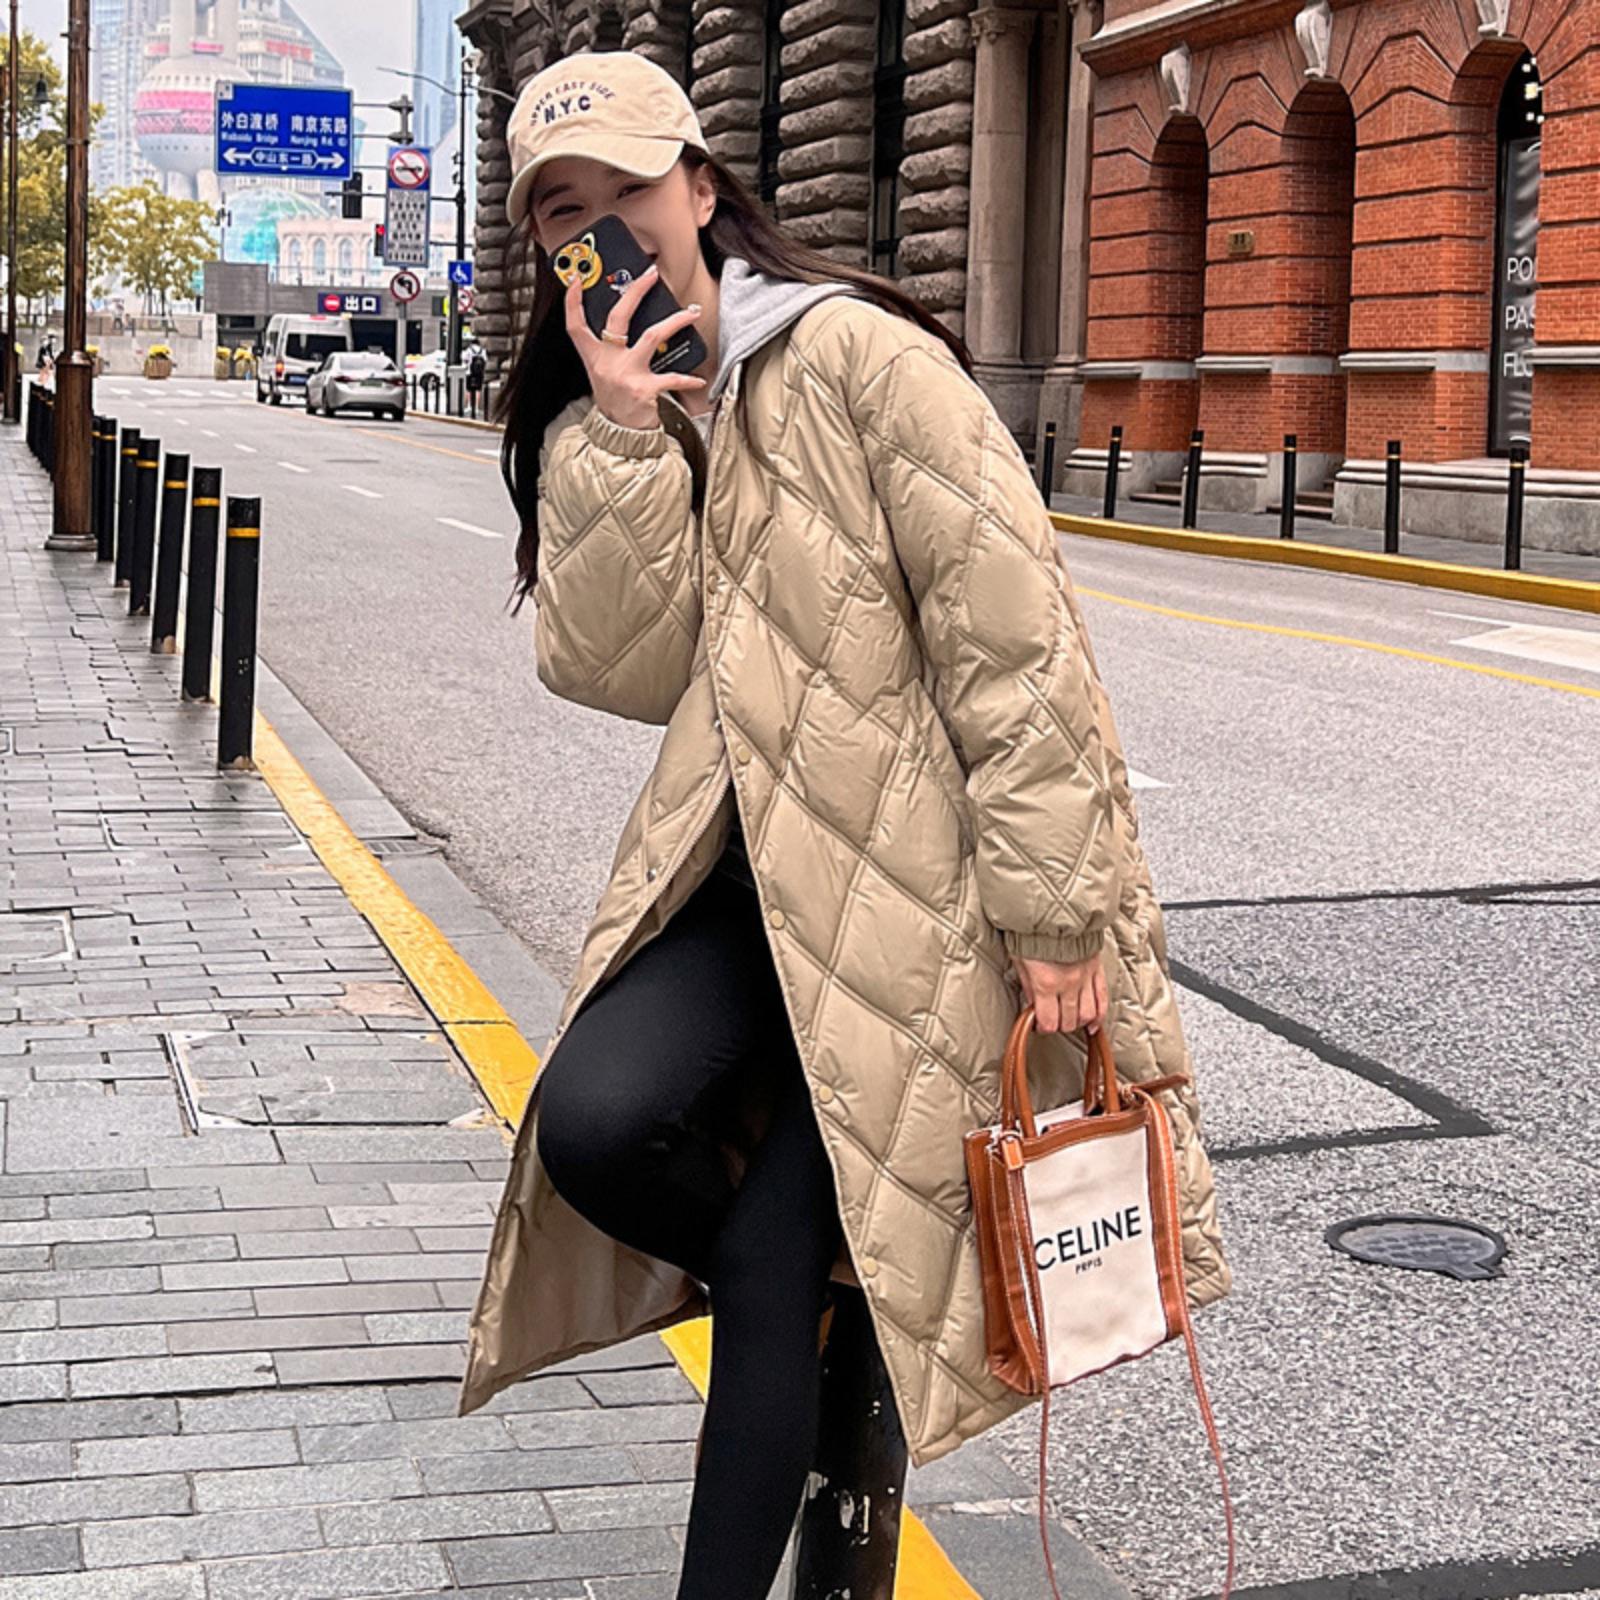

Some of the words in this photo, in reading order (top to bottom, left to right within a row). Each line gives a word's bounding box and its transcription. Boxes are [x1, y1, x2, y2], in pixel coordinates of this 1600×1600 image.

[221, 111, 279, 131] 外白渡桥
[291, 115, 348, 135] 南京东路
[1507, 257, 1537, 281] PO
[344, 295, 377, 312] 出口
[1034, 1205, 1143, 1270] CELINE
